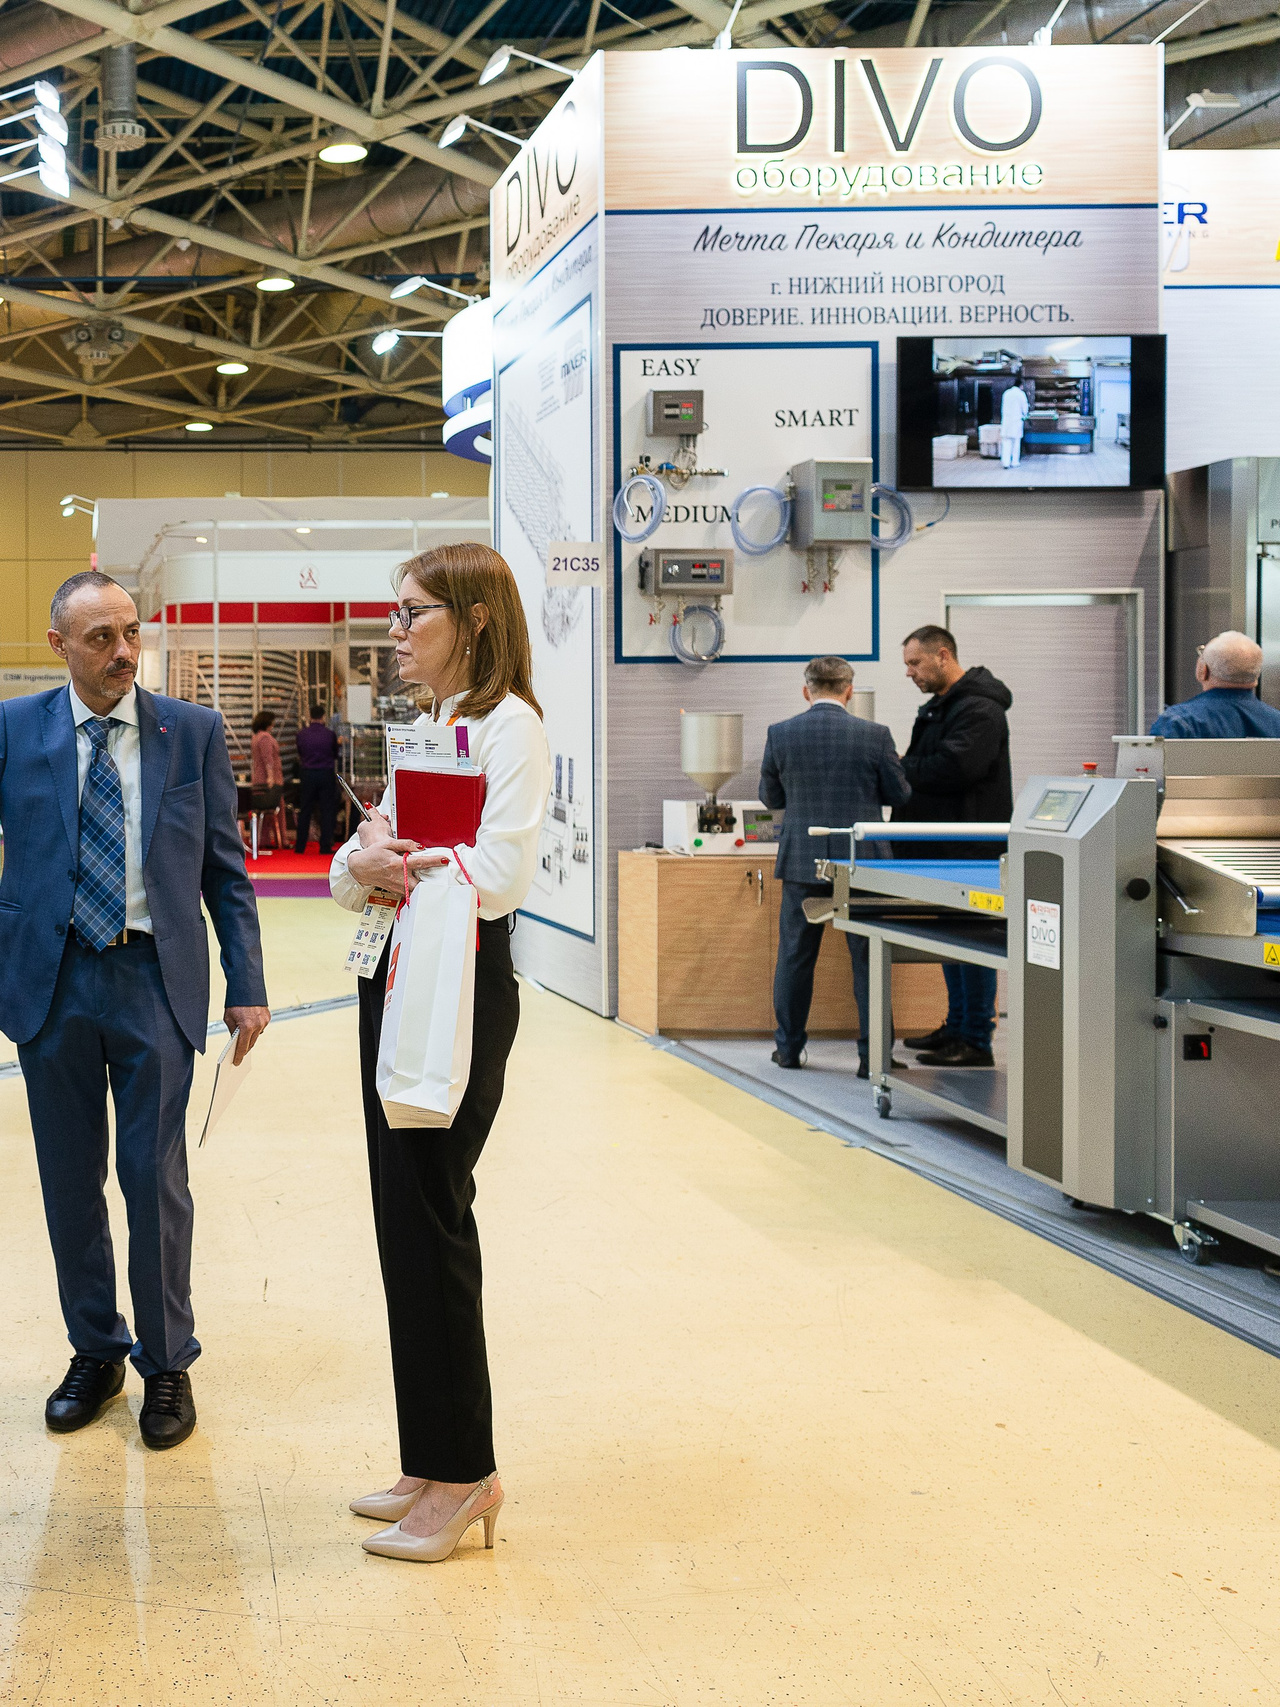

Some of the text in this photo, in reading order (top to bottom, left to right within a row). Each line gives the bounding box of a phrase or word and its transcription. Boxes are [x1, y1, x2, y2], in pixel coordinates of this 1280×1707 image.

[736, 56, 1043, 153] DIVO
[506, 100, 578, 257] DIVO
[736, 159, 1043, 196] оборудование
[693, 221, 1084, 257] Мечта Пекаря и Кондитера
[771, 271, 1006, 296] г. НИЖНИЙ НОВГОРОД
[701, 303, 1075, 330] ДОВЕРИЕ. ИННОВАЦИИ. ВЕРНОСТЬ.
[640, 358, 702, 377] EASY
[774, 408, 859, 428] SMART
[634, 505, 741, 523] MEDIUM
[552, 556, 600, 572] 21C35
[1031, 925, 1057, 943] DIVO
